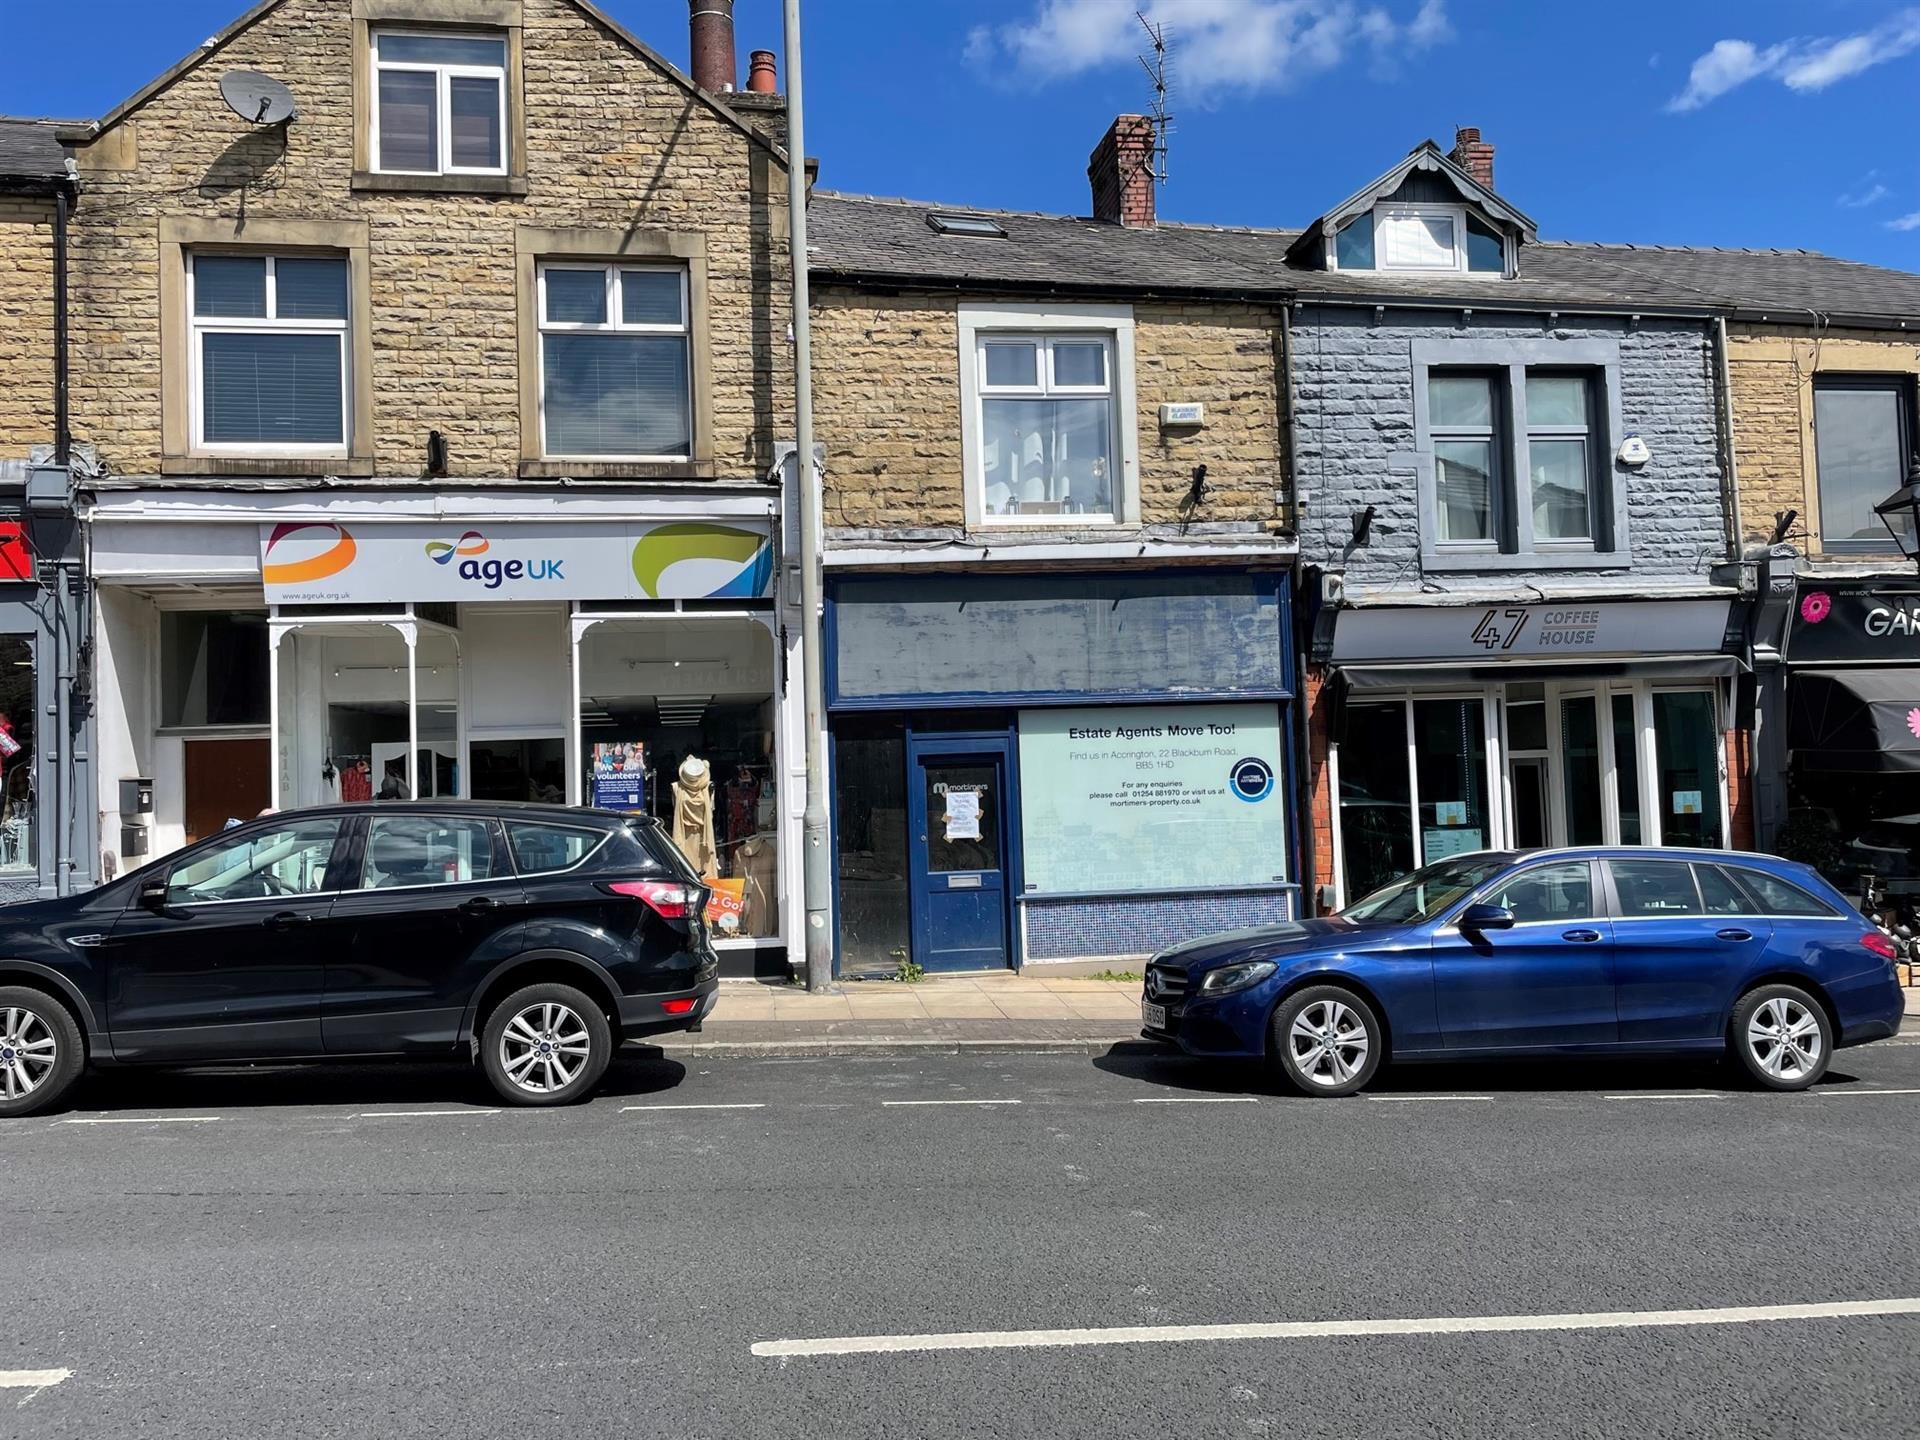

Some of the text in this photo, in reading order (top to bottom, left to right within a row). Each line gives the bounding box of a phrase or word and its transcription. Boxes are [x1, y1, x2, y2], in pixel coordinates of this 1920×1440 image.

[459, 560, 565, 589] age UK
[282, 592, 350, 600] www.ageuk.org.uk
[1471, 609, 1599, 649] 47 COFFEE
[1539, 630, 1595, 645] HOUSE
[1069, 723, 1236, 740] Estate Agents Move Too!
[1069, 751, 1087, 760] Find
[1101, 751, 1108, 759] in
[1159, 750, 1169, 758] 22
[1172, 748, 1212, 757] Blackburn
[1136, 760, 1174, 769] BB5 1HD
[597, 771, 640, 780] volunteers
[1136, 781, 1148, 790] any
[1150, 780, 1183, 788] enquiries
[1089, 791, 1113, 800] please
[1132, 790, 1153, 798] 01254
[1191, 788, 1206, 796] visit
[1110, 797, 1201, 807] mortimers-property.co.uk
[721, 896, 744, 912] Go!
